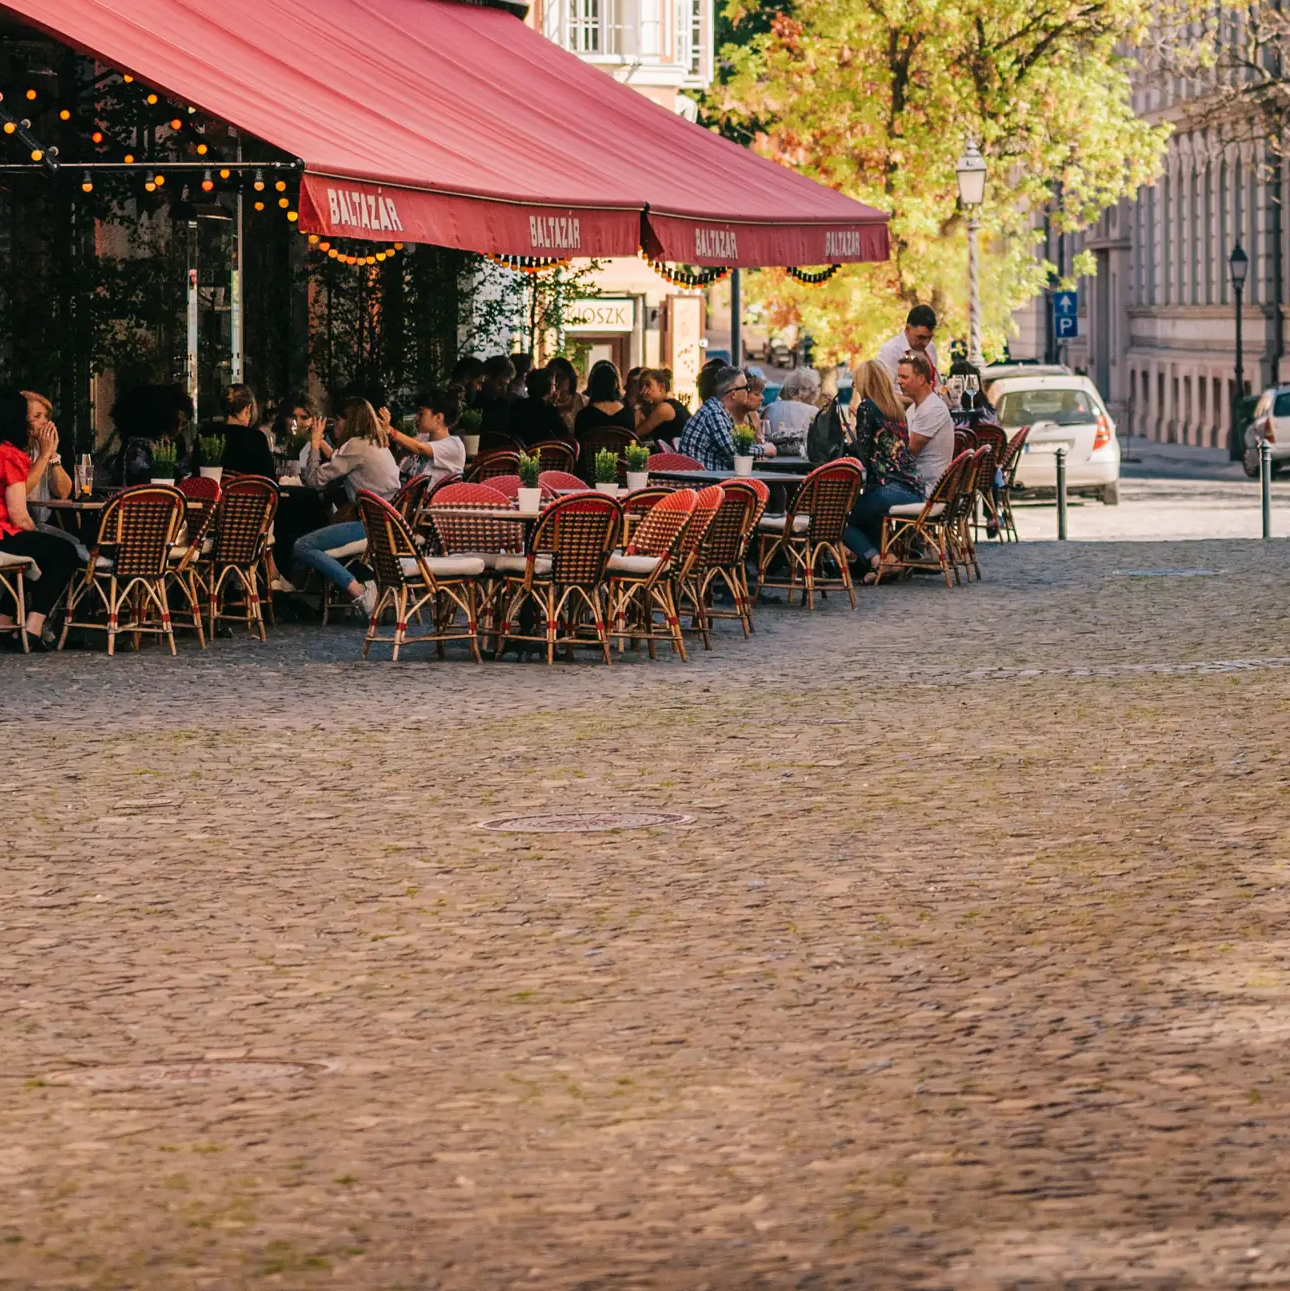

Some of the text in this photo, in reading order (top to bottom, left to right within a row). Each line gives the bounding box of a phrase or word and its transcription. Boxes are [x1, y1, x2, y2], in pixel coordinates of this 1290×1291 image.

[327, 187, 404, 232] BALTAZÁR
[529, 210, 581, 249] BALTAZÁR
[695, 225, 738, 259] BALTAZÁR
[825, 226, 861, 256] BALTAZÁR
[567, 307, 626, 324] KIOSZK
[1060, 317, 1073, 335] P
